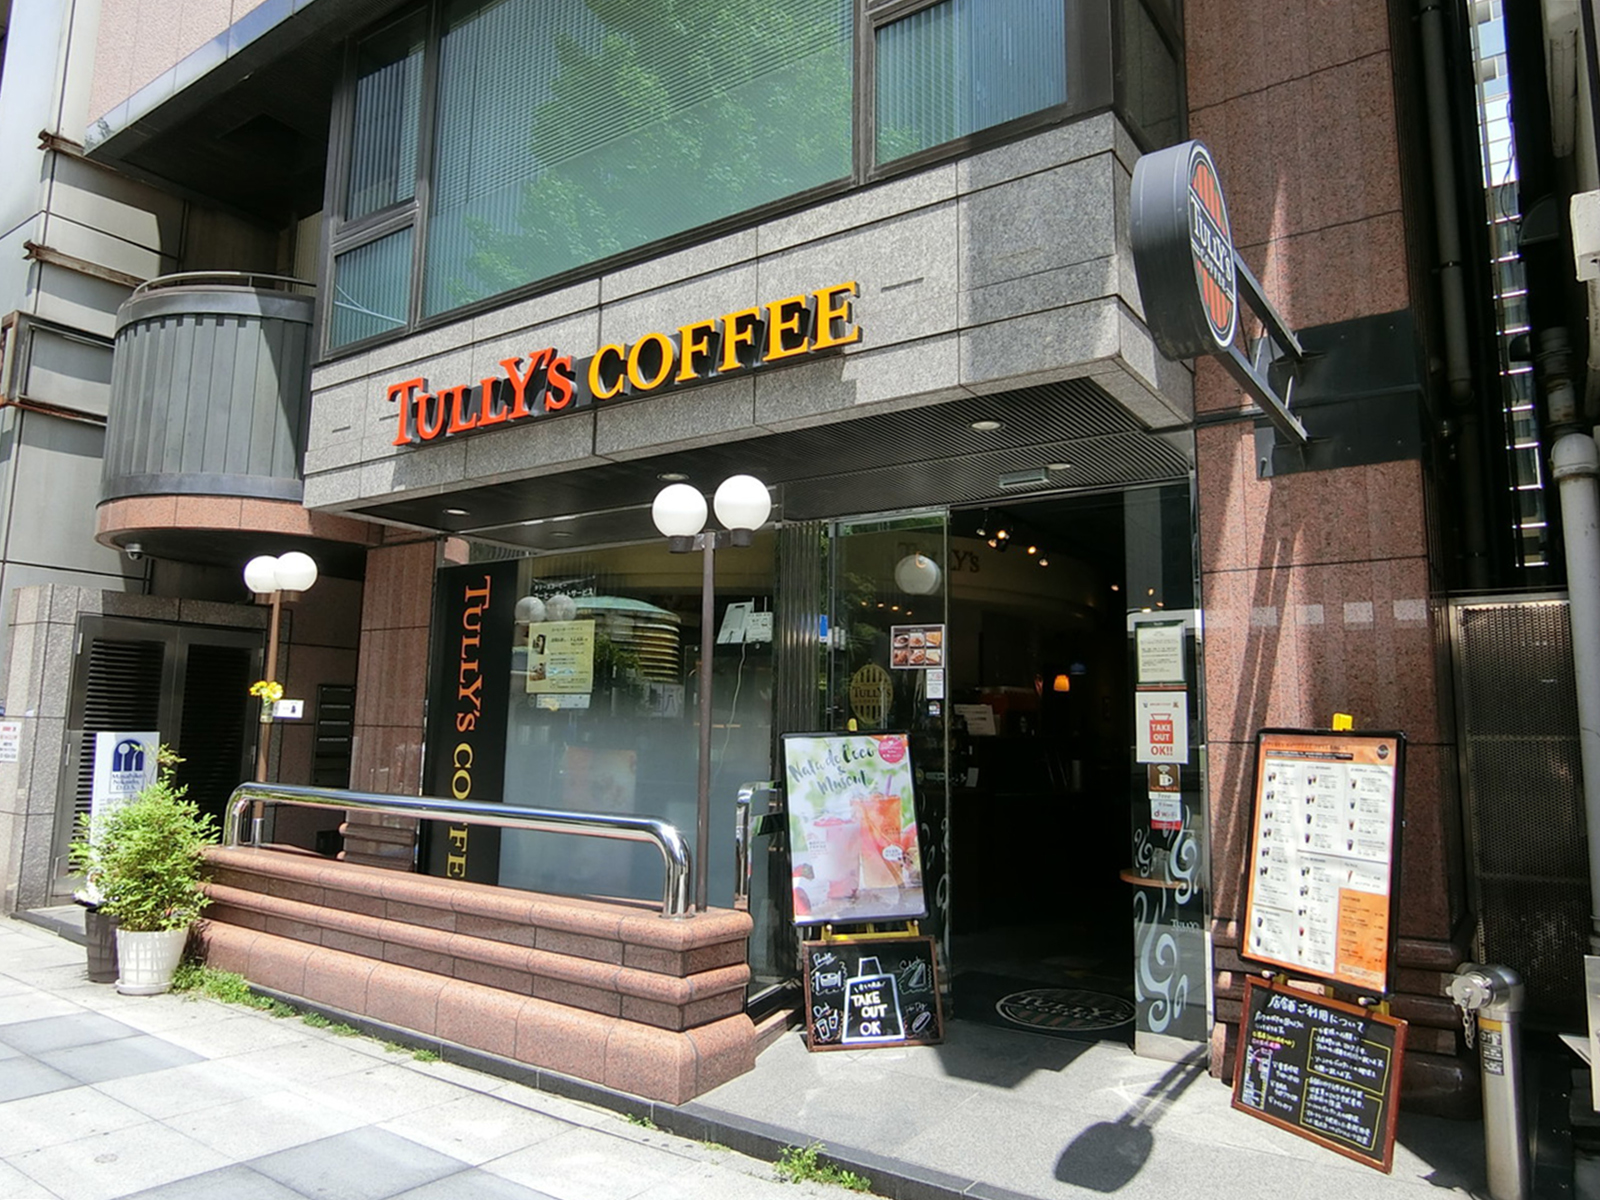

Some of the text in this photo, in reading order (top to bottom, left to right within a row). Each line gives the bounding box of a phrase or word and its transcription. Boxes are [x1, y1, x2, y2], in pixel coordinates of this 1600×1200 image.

[588, 281, 863, 400] COFFEE
[1151, 723, 1171, 732] TAKE
[1153, 733, 1170, 741] OUT
[1150, 745, 1173, 756] OK!!
[788, 759, 824, 783] Nata
[850, 991, 881, 1007] TAKE
[861, 1003, 888, 1019] OUT
[859, 1020, 882, 1036] OK
